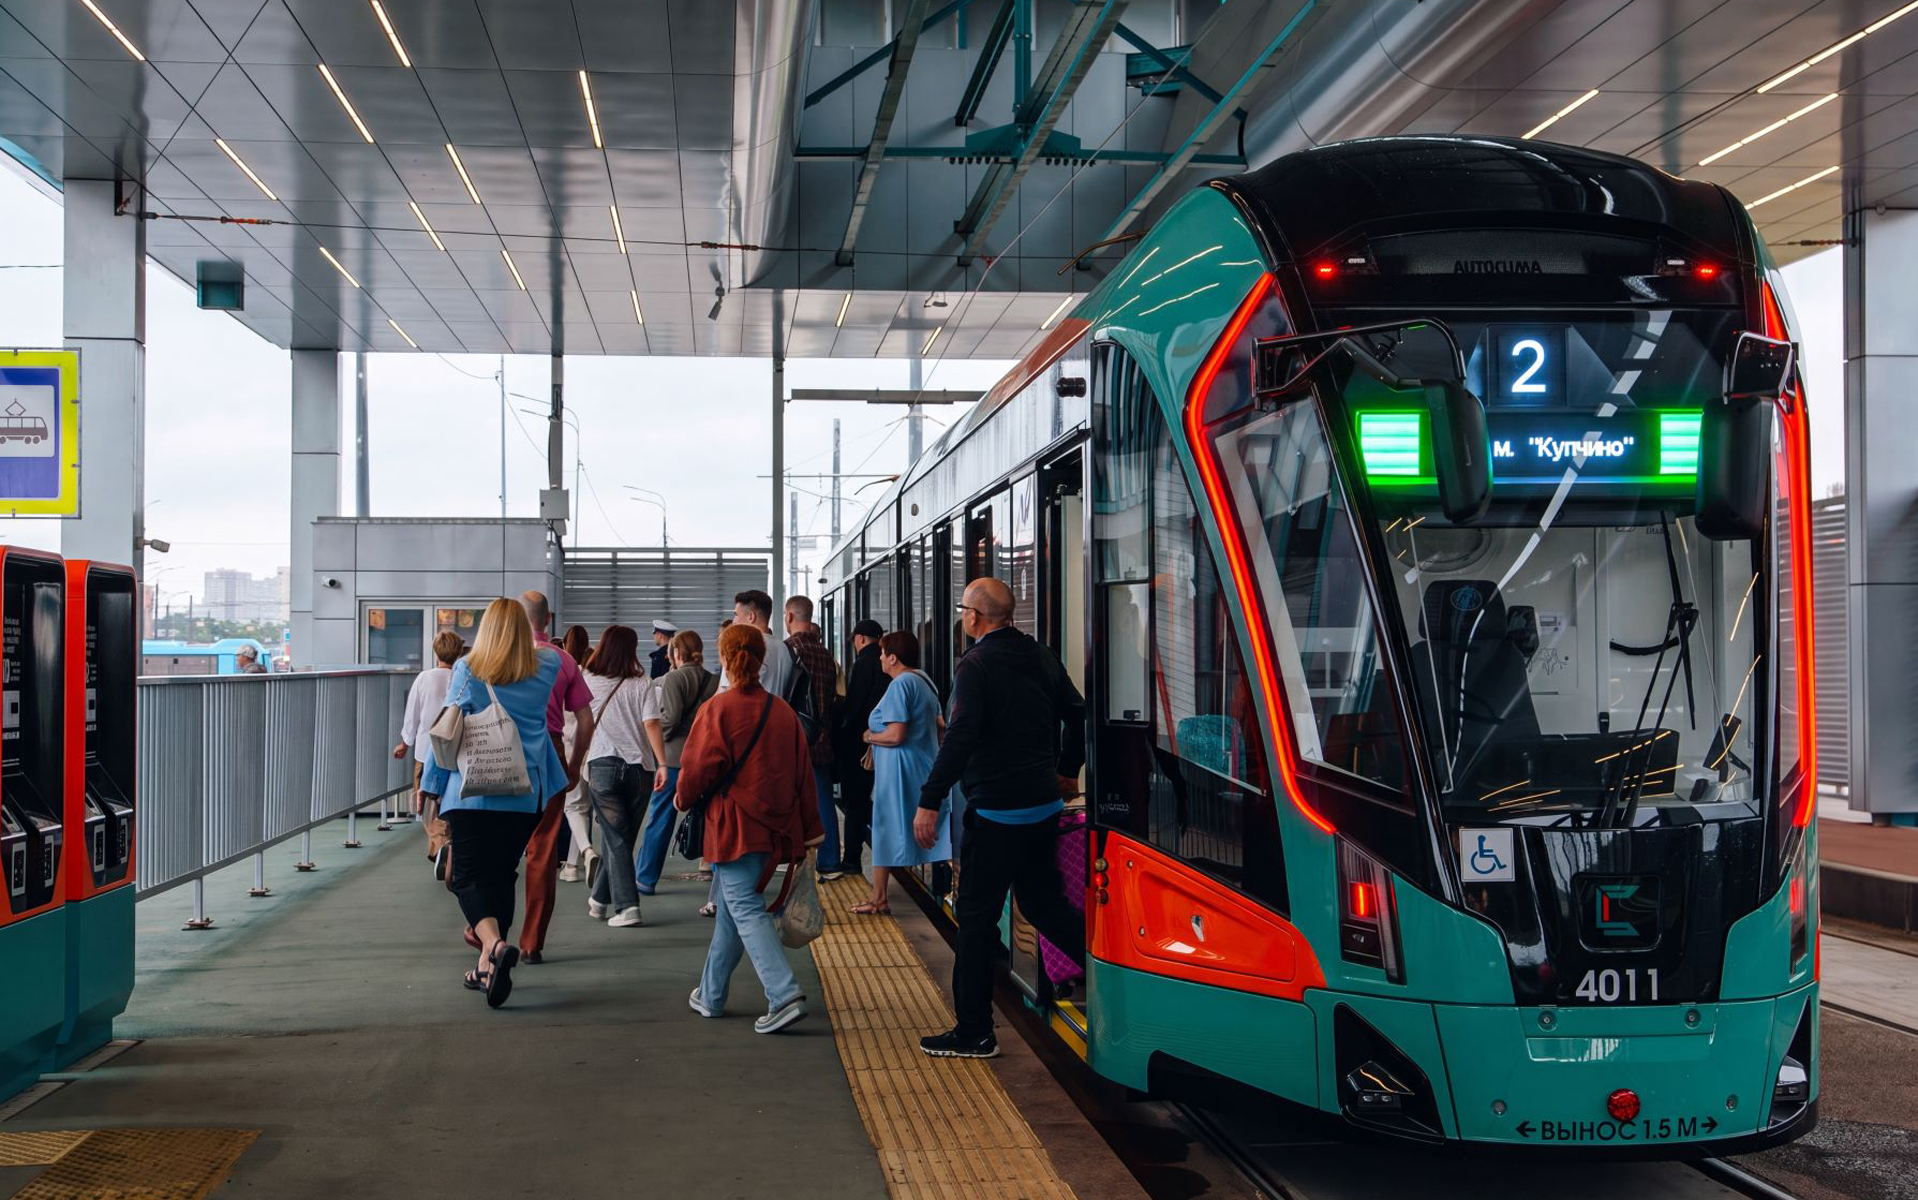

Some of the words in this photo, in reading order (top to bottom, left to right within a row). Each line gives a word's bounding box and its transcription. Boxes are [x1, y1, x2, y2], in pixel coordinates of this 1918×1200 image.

[1454, 260, 1542, 274] AUTOCLIMA
[1511, 339, 1546, 393] 2
[1493, 440, 1515, 458] м.
[1528, 436, 1635, 462] "Купчино"
[1575, 968, 1658, 1002] 4011
[1540, 1120, 1637, 1141] ВЫНОС
[1642, 1117, 1672, 1140] 1.5
[1677, 1116, 1697, 1138] М
